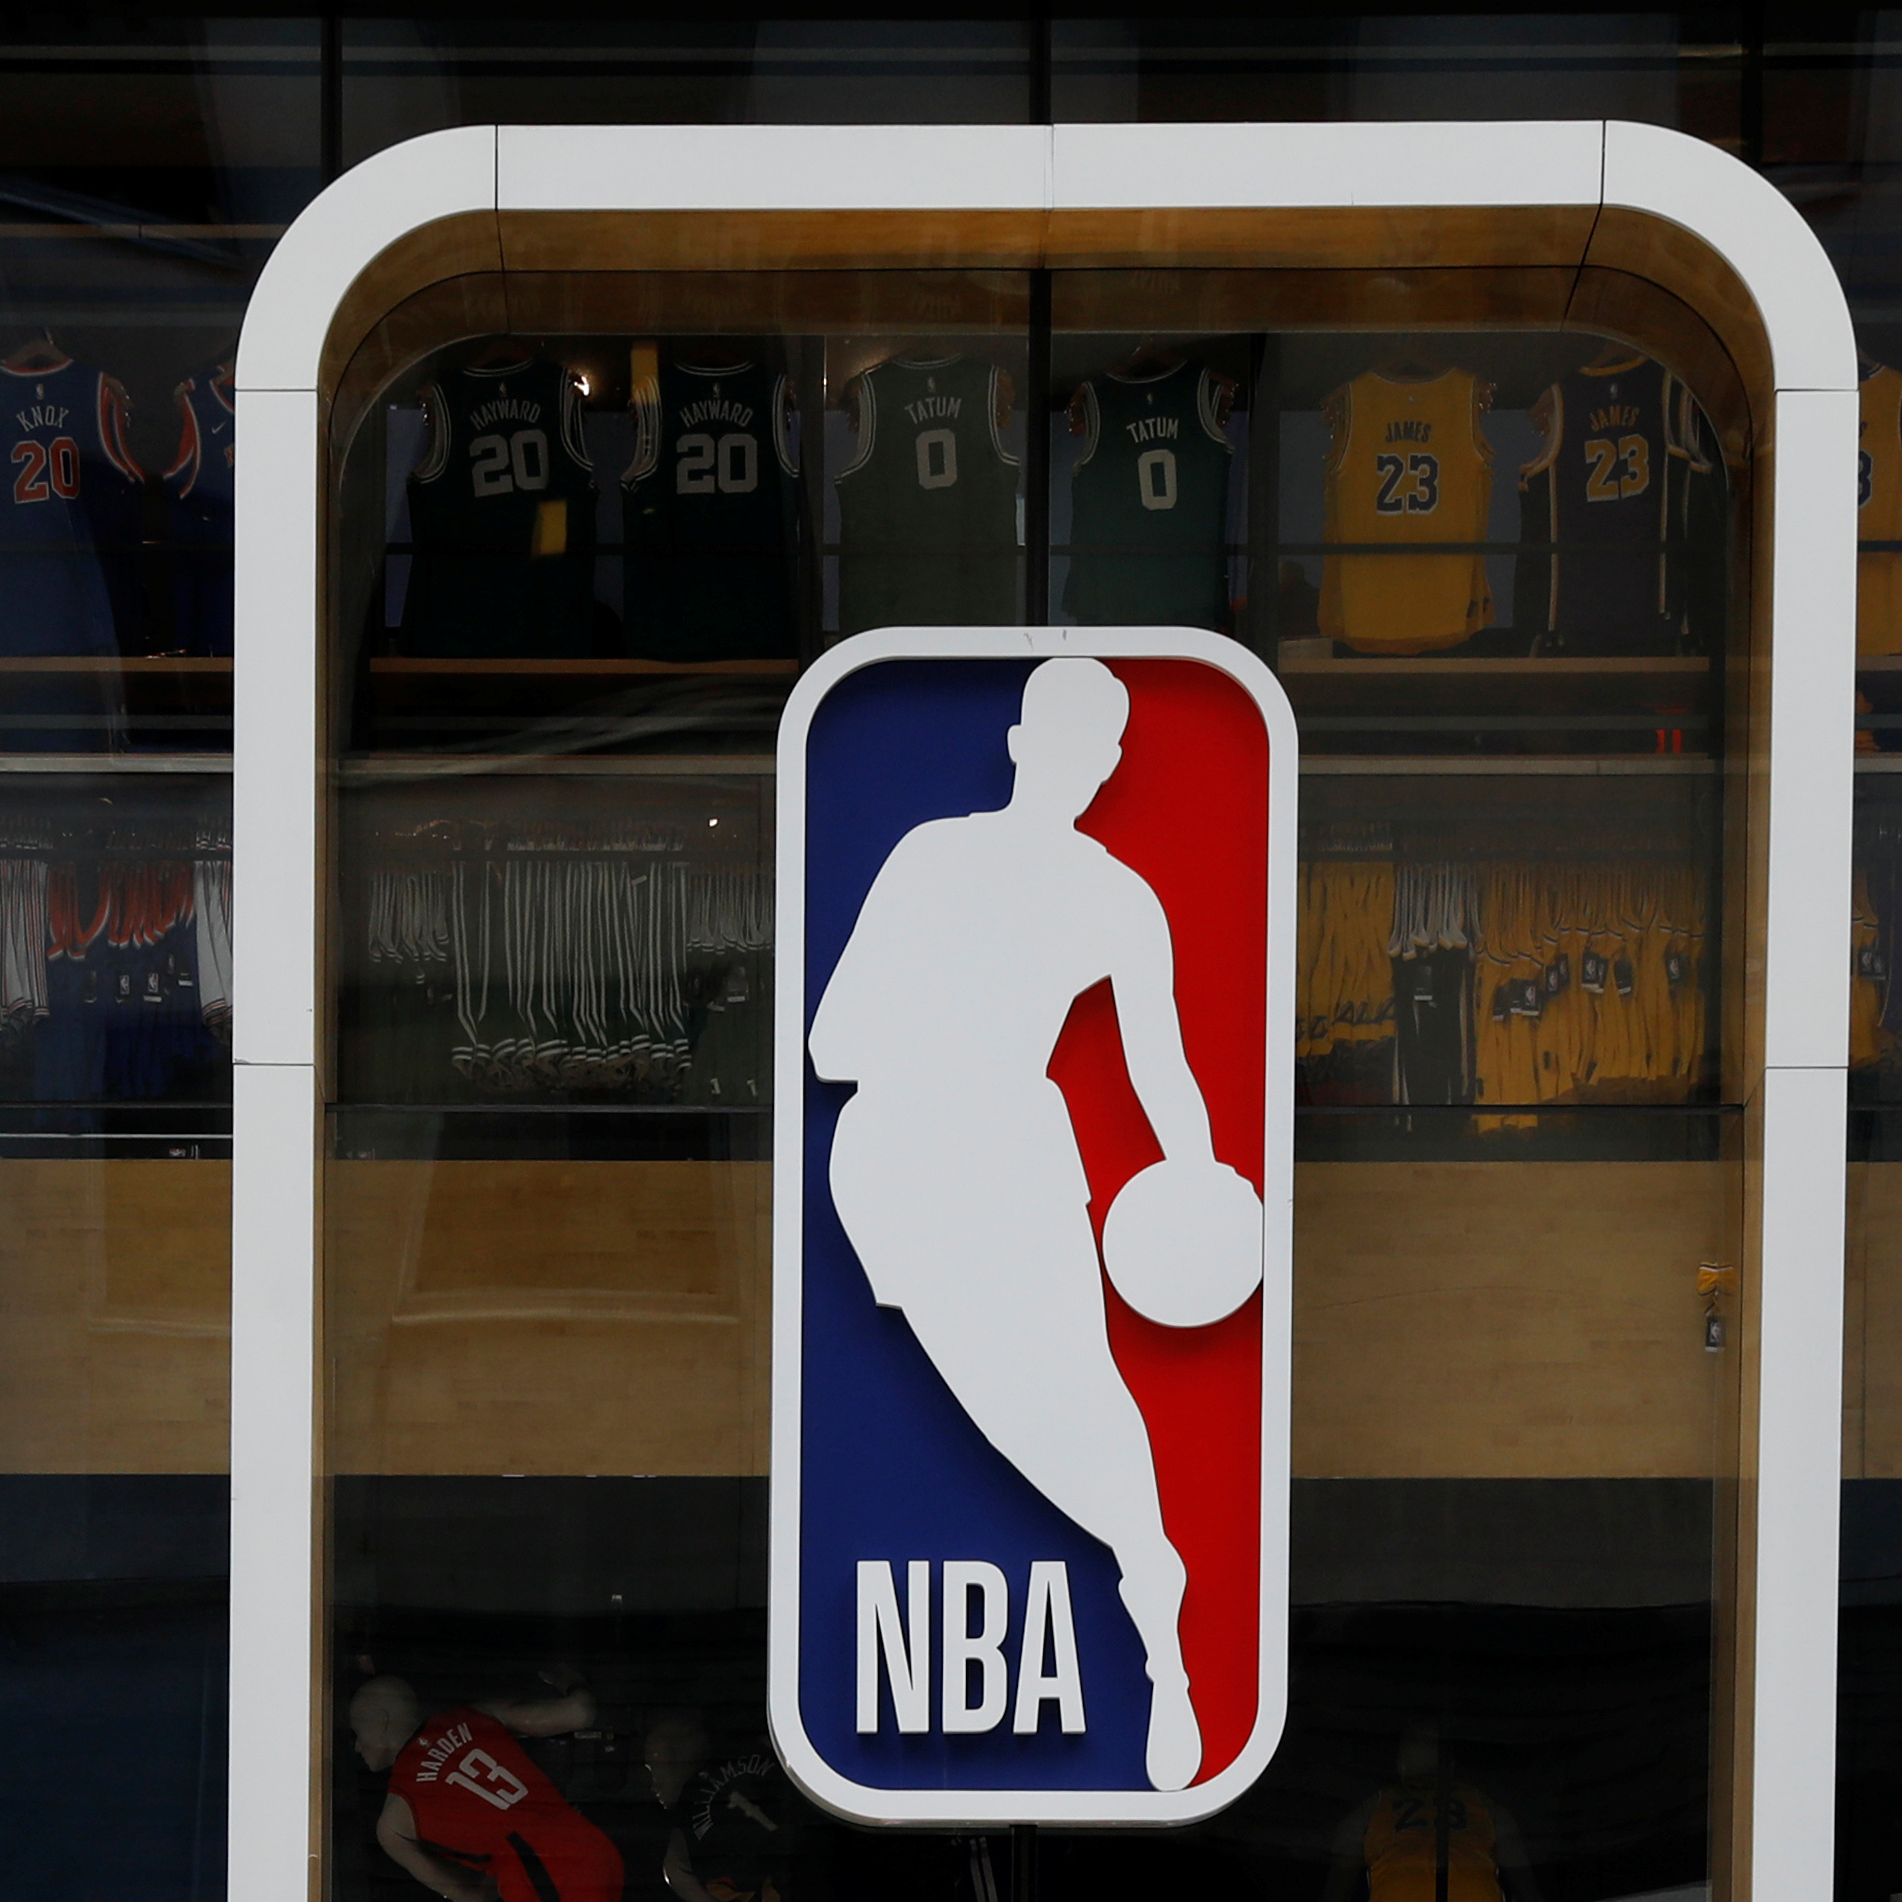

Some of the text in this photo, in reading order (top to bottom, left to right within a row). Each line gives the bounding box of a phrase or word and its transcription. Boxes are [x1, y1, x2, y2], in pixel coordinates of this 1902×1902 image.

[15, 404, 70, 433] KNOX
[468, 399, 542, 431] HAYWARD
[678, 399, 755, 429] HAYWARD
[904, 396, 962, 425] TATUM
[1125, 416, 1179, 444] TATUM
[1385, 420, 1433, 444] JAMES
[1588, 405, 1641, 433] JAMES
[10, 436, 81, 504] 20
[468, 428, 550, 498] 20
[676, 433, 758, 494] 20
[915, 427, 958, 490] 0
[1136, 448, 1178, 511] 0
[1376, 453, 1439, 516] 23
[1583, 433, 1650, 503] 23
[854, 1559, 1088, 1735] NBA
[415, 1721, 474, 1784] HARDEN
[445, 1746, 529, 1811] 13
